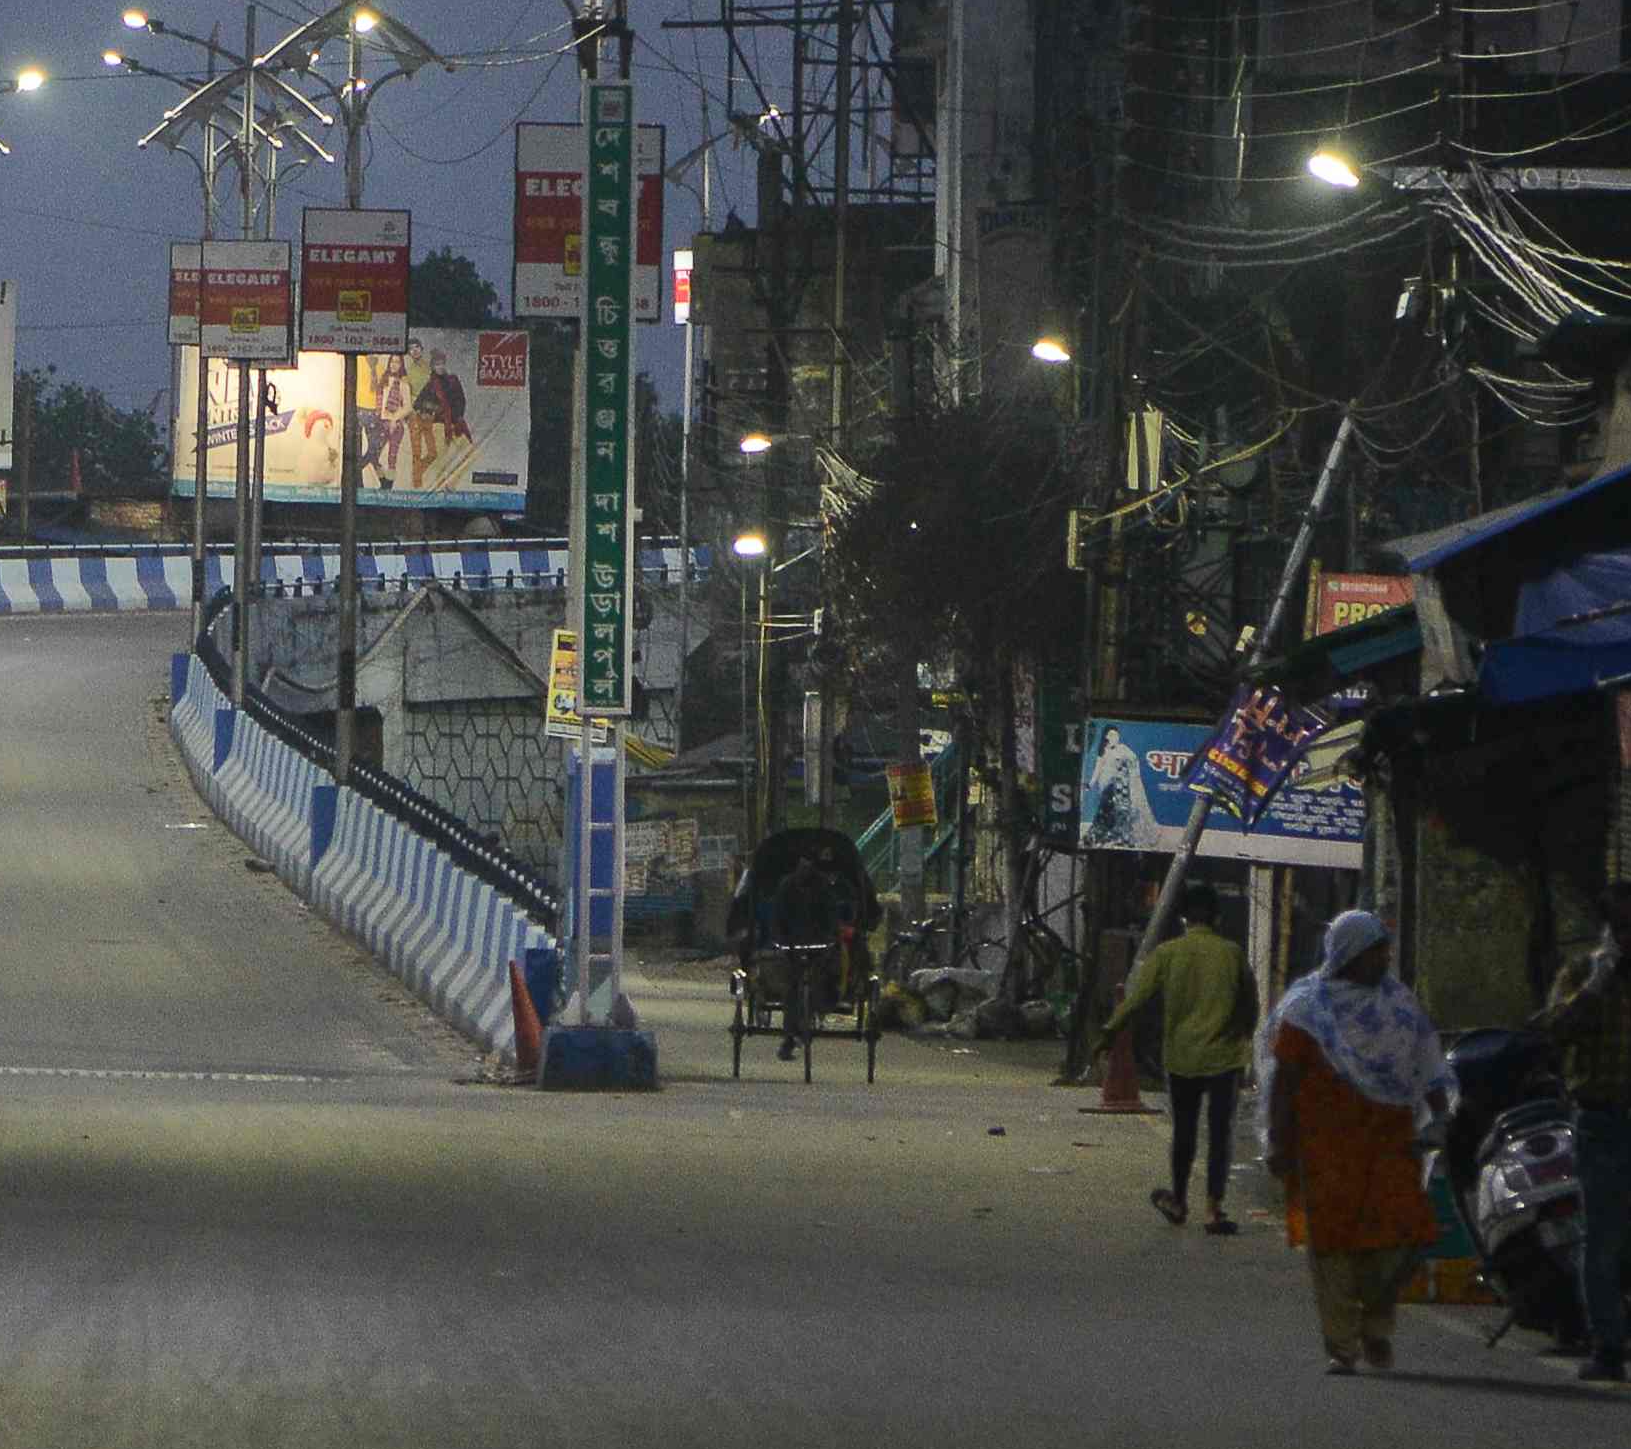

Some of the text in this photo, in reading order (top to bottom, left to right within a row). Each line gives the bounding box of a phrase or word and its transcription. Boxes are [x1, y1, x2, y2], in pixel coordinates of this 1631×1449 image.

[308, 247, 398, 265] ELEGANT
[206, 273, 282, 287] ELEGANT
[480, 353, 523, 370] STYLE
